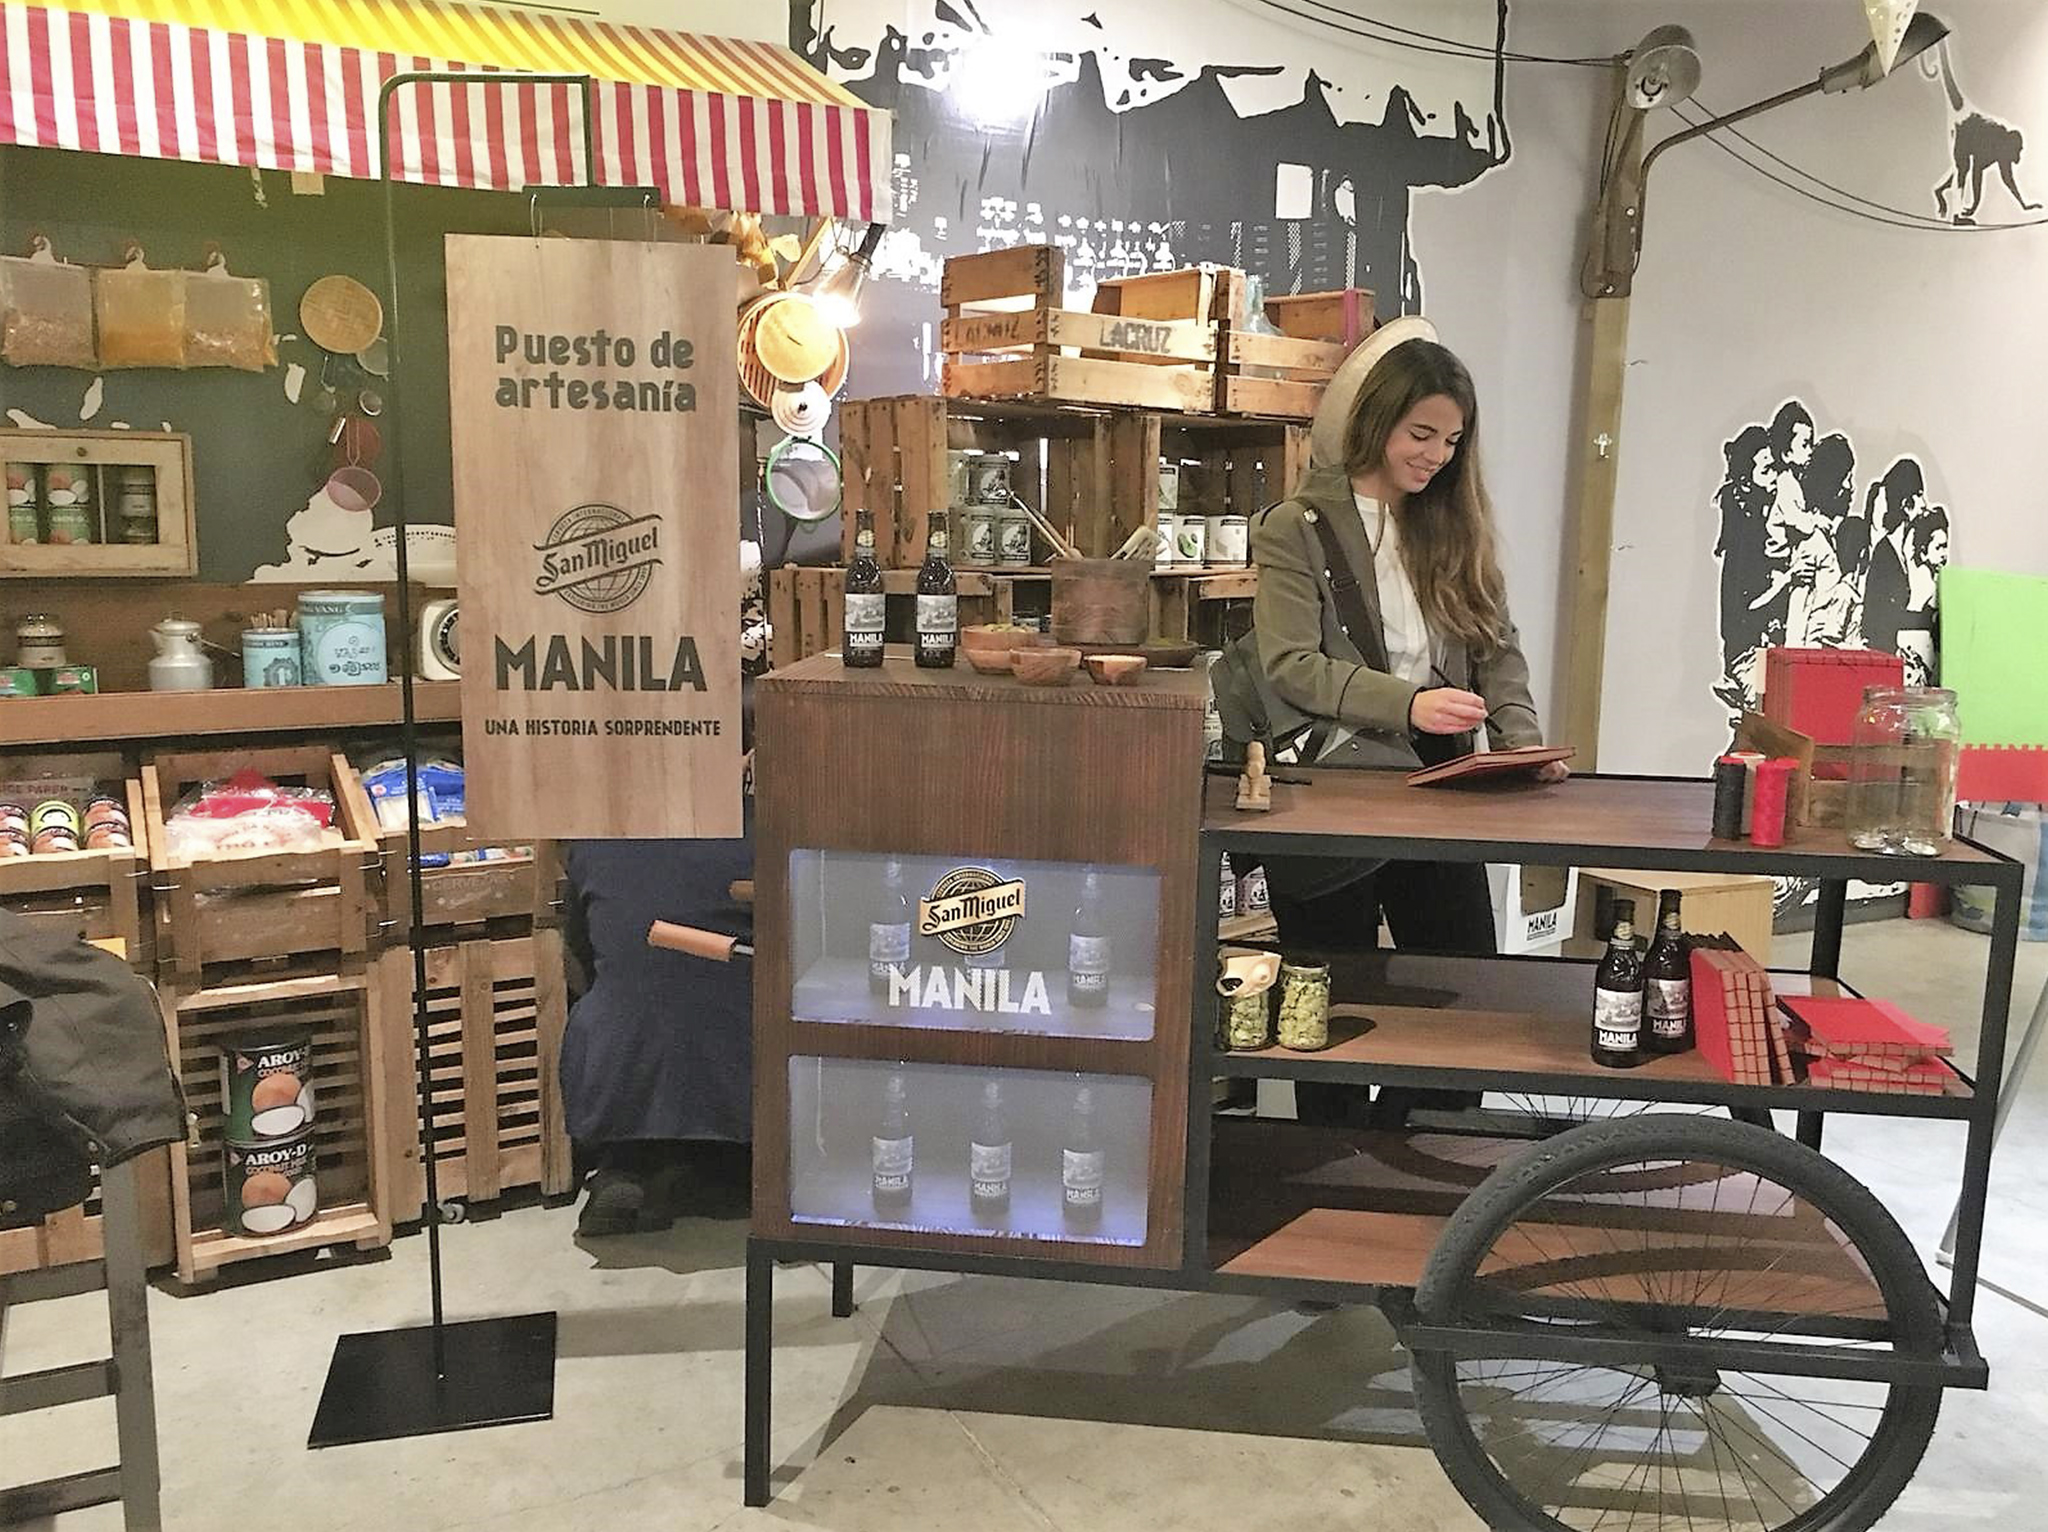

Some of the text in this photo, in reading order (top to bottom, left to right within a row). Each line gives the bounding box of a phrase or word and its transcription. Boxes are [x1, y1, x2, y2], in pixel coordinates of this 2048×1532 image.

[495, 325, 694, 369] Puesto de
[1100, 321, 1172, 354] LACRUZ
[495, 371, 697, 412] artesanía
[494, 634, 708, 692] MANILA
[485, 719, 721, 736] UNA HISTORIA SORPRENDENTE
[1528, 912, 1557, 933] MANILA
[888, 963, 1052, 1016] MANILA
[1599, 1029, 1637, 1046] MANILA
[245, 1143, 306, 1166] AROY-D
